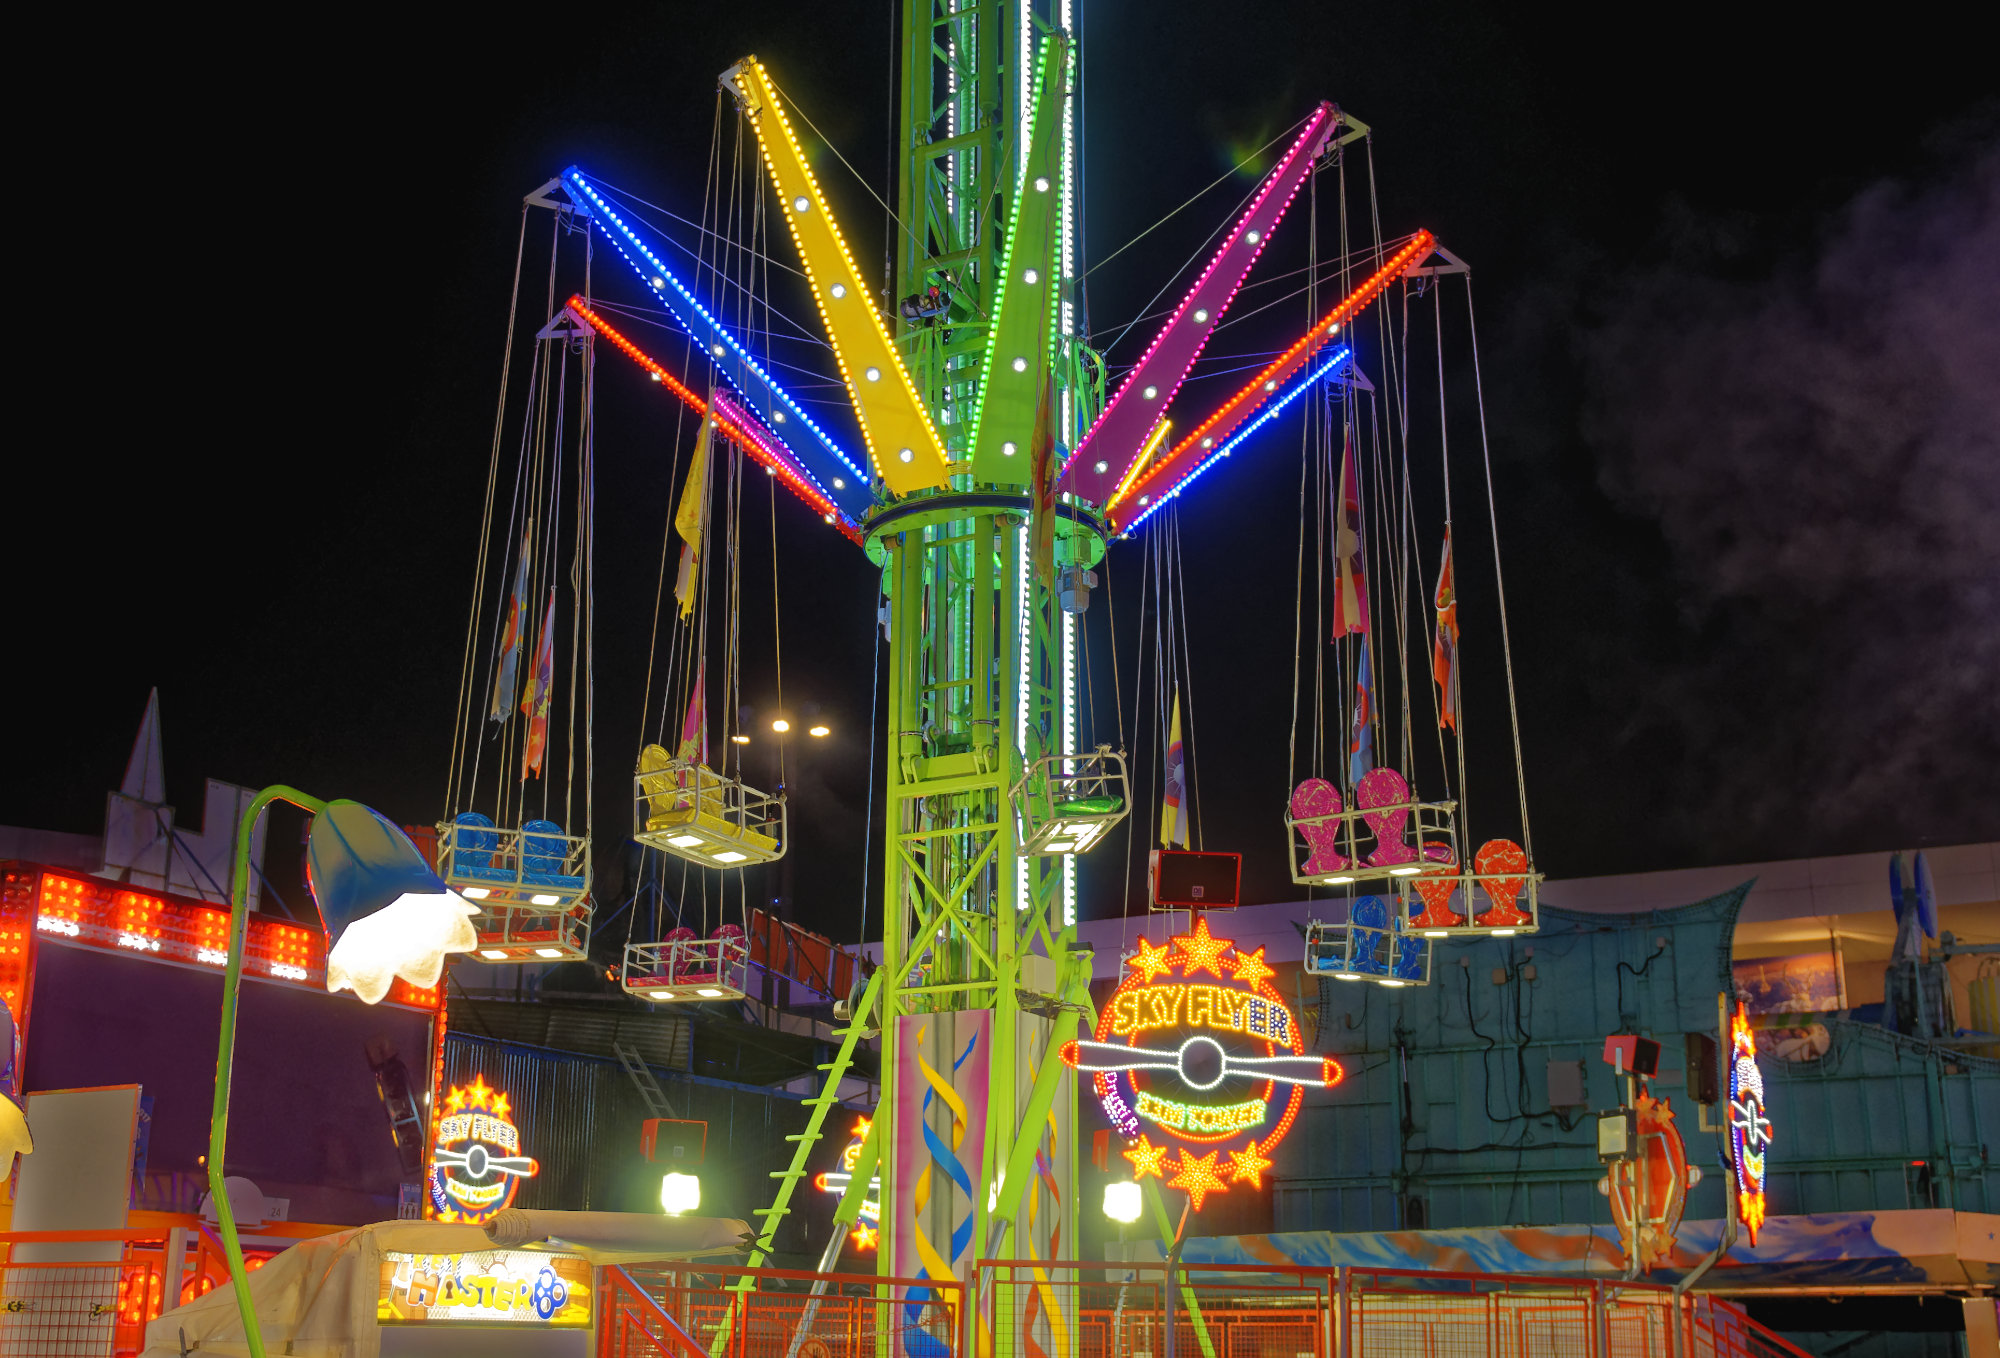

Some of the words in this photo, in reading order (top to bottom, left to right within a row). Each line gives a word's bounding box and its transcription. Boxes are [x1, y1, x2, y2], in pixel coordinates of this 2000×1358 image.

[1111, 984, 1185, 1036] SKY
[1187, 984, 1292, 1048] FLYER
[438, 1113, 473, 1145] SKY
[472, 1113, 519, 1154] FLYER
[407, 1269, 534, 1312] MASTER
